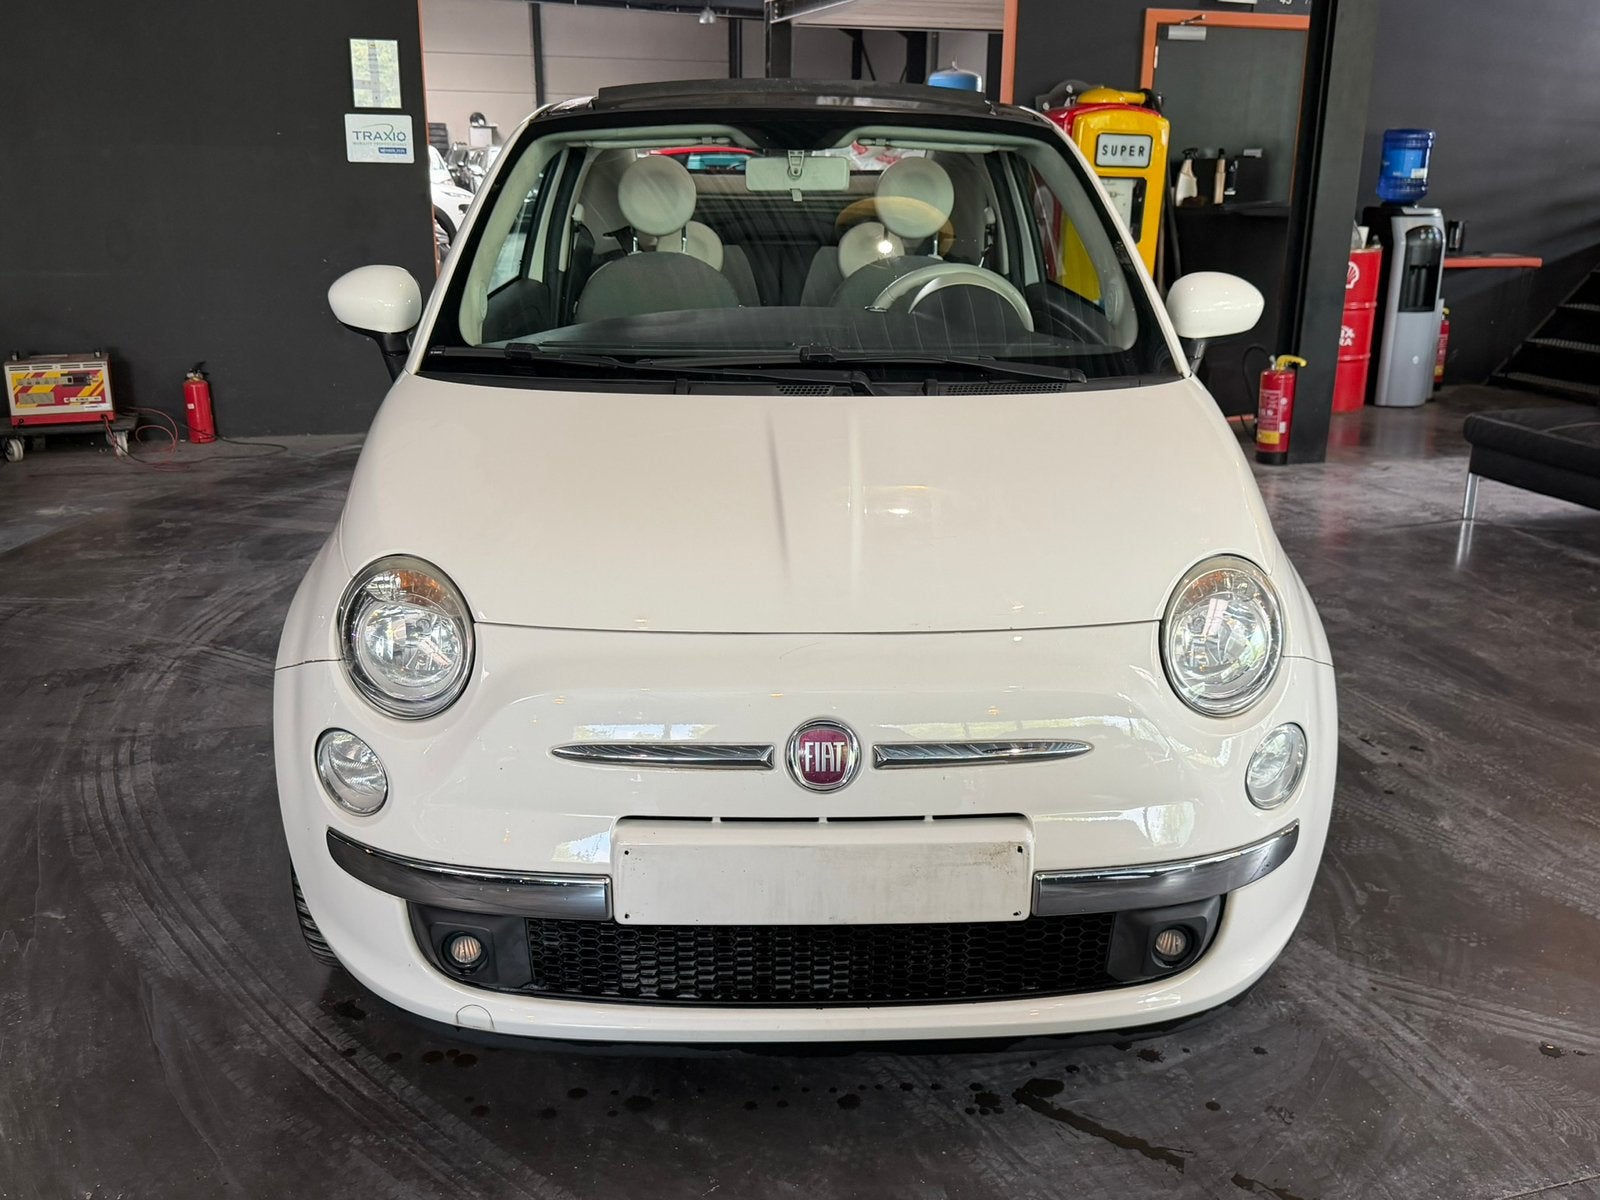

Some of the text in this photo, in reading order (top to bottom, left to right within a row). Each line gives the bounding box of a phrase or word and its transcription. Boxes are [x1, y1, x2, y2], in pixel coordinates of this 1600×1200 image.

[352, 130, 407, 142] TRAXIO
[1102, 144, 1145, 157] SUPER
[805, 742, 845, 772] FIAT
